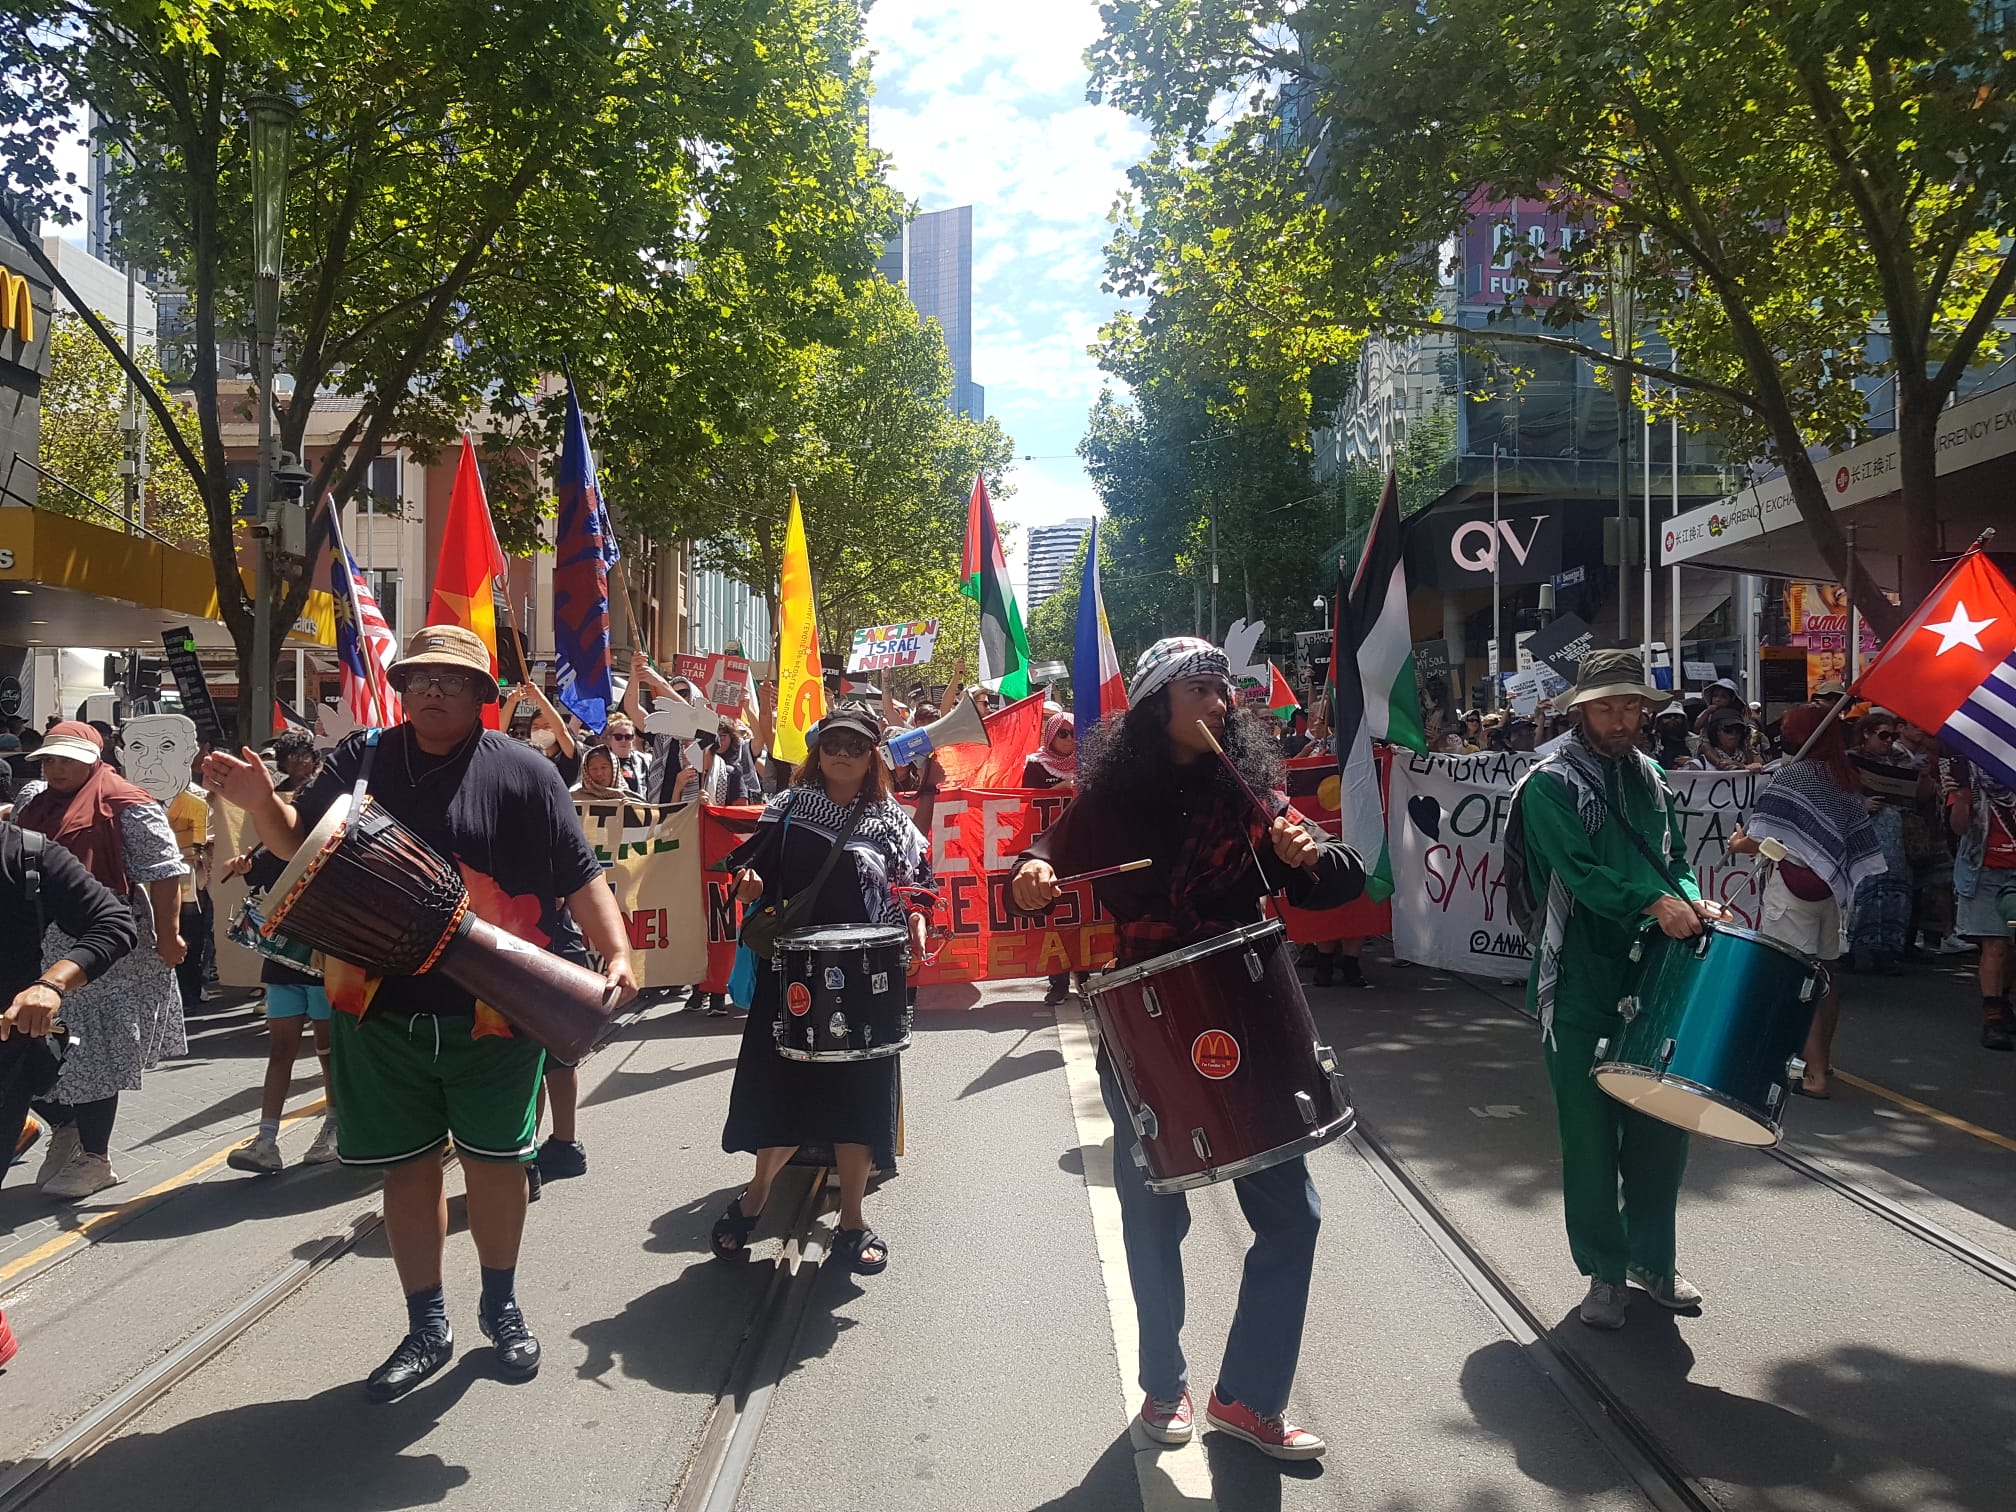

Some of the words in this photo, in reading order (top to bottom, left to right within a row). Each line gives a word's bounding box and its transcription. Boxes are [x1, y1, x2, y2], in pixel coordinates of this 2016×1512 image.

[1765, 492, 1797, 513] EXCHA
[1450, 514, 1551, 573] QV
[854, 619, 936, 645] SANCTION
[865, 637, 921, 656] ISRAEL
[1548, 631, 1594, 662] PALESTINE
[1564, 643, 1592, 662] NEEDS
[727, 660, 749, 671] FREE
[859, 651, 917, 671] NOW
[1428, 656, 1447, 667] SOUL
[681, 668, 705, 679] STAR
